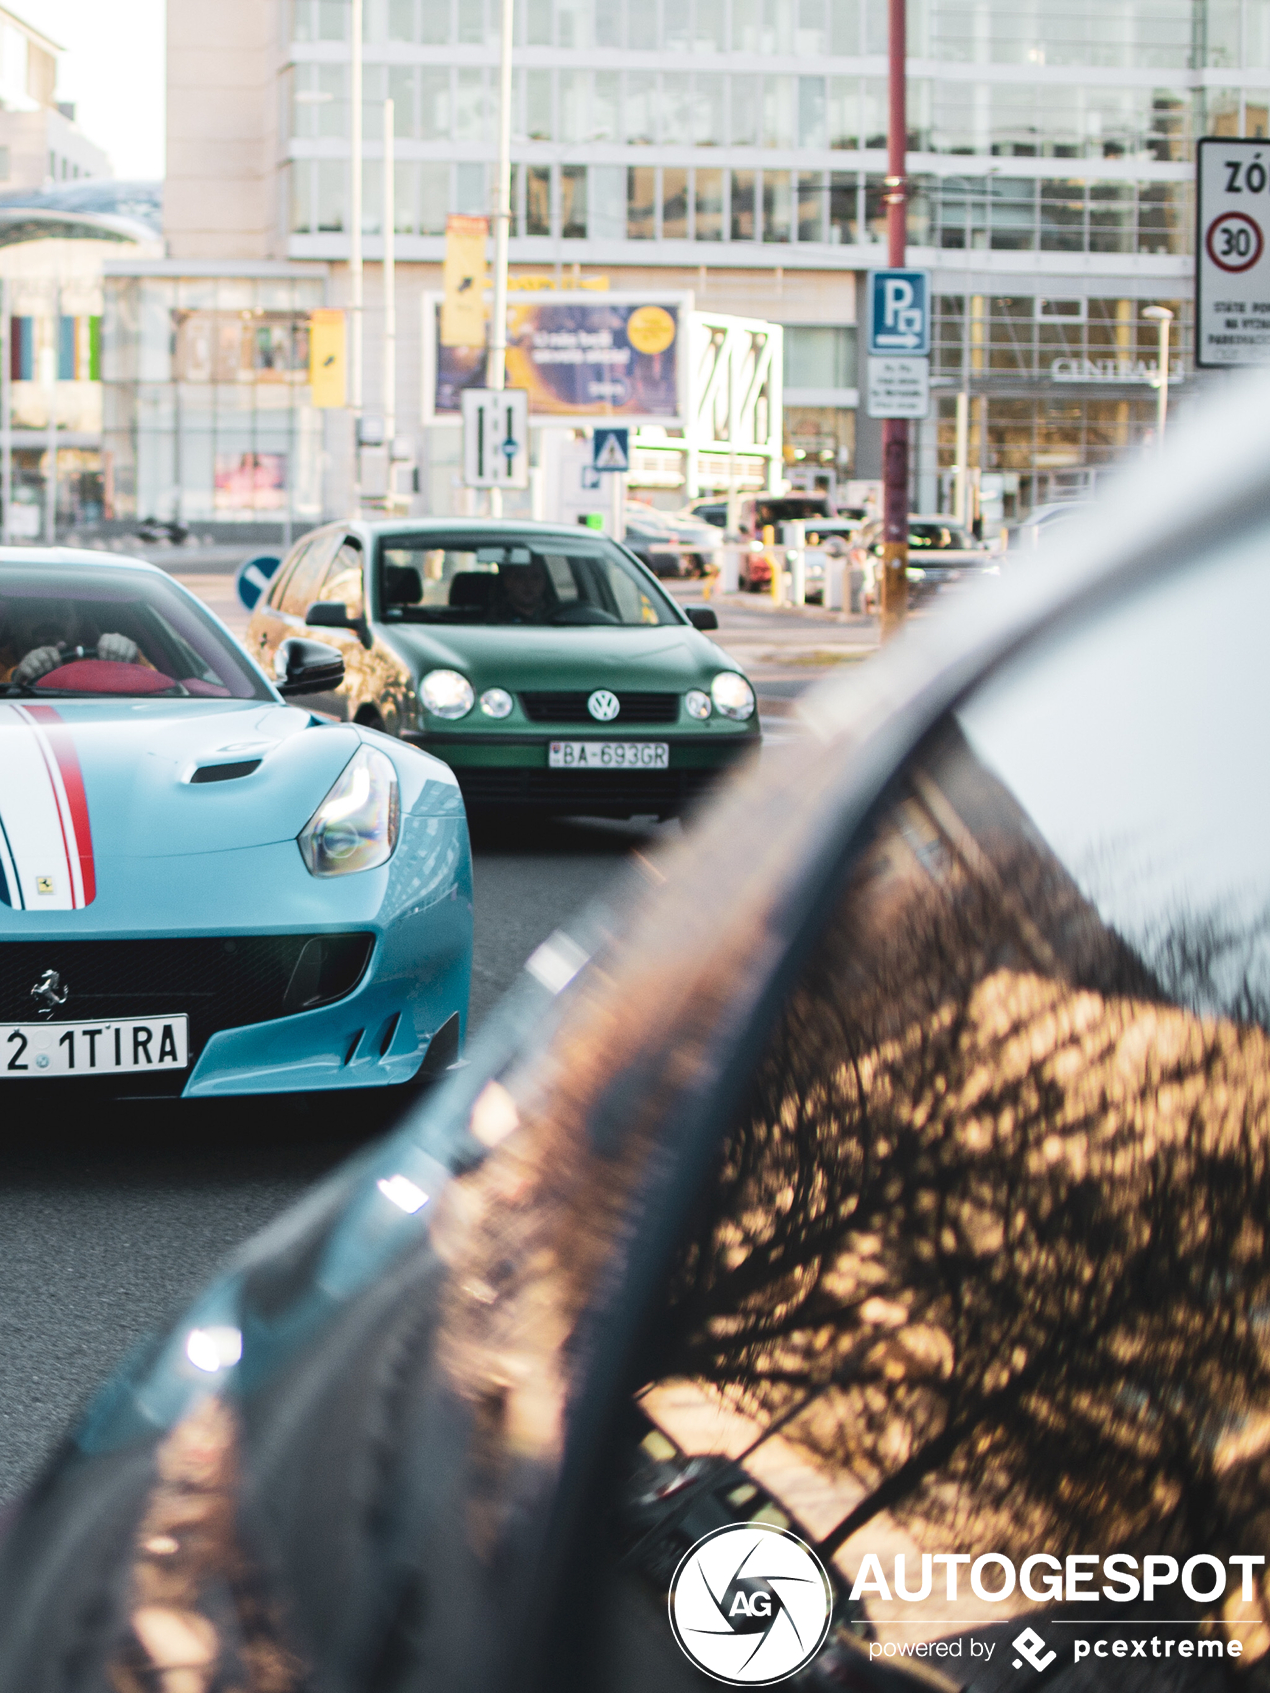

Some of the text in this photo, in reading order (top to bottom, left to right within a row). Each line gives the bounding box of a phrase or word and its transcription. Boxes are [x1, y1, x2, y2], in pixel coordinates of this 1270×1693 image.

[1224, 152, 1270, 193] ZÓ
[1220, 228, 1250, 257] 30
[563, 745, 666, 765] BA-693GR
[59, 1023, 179, 1069] 1TIRA
